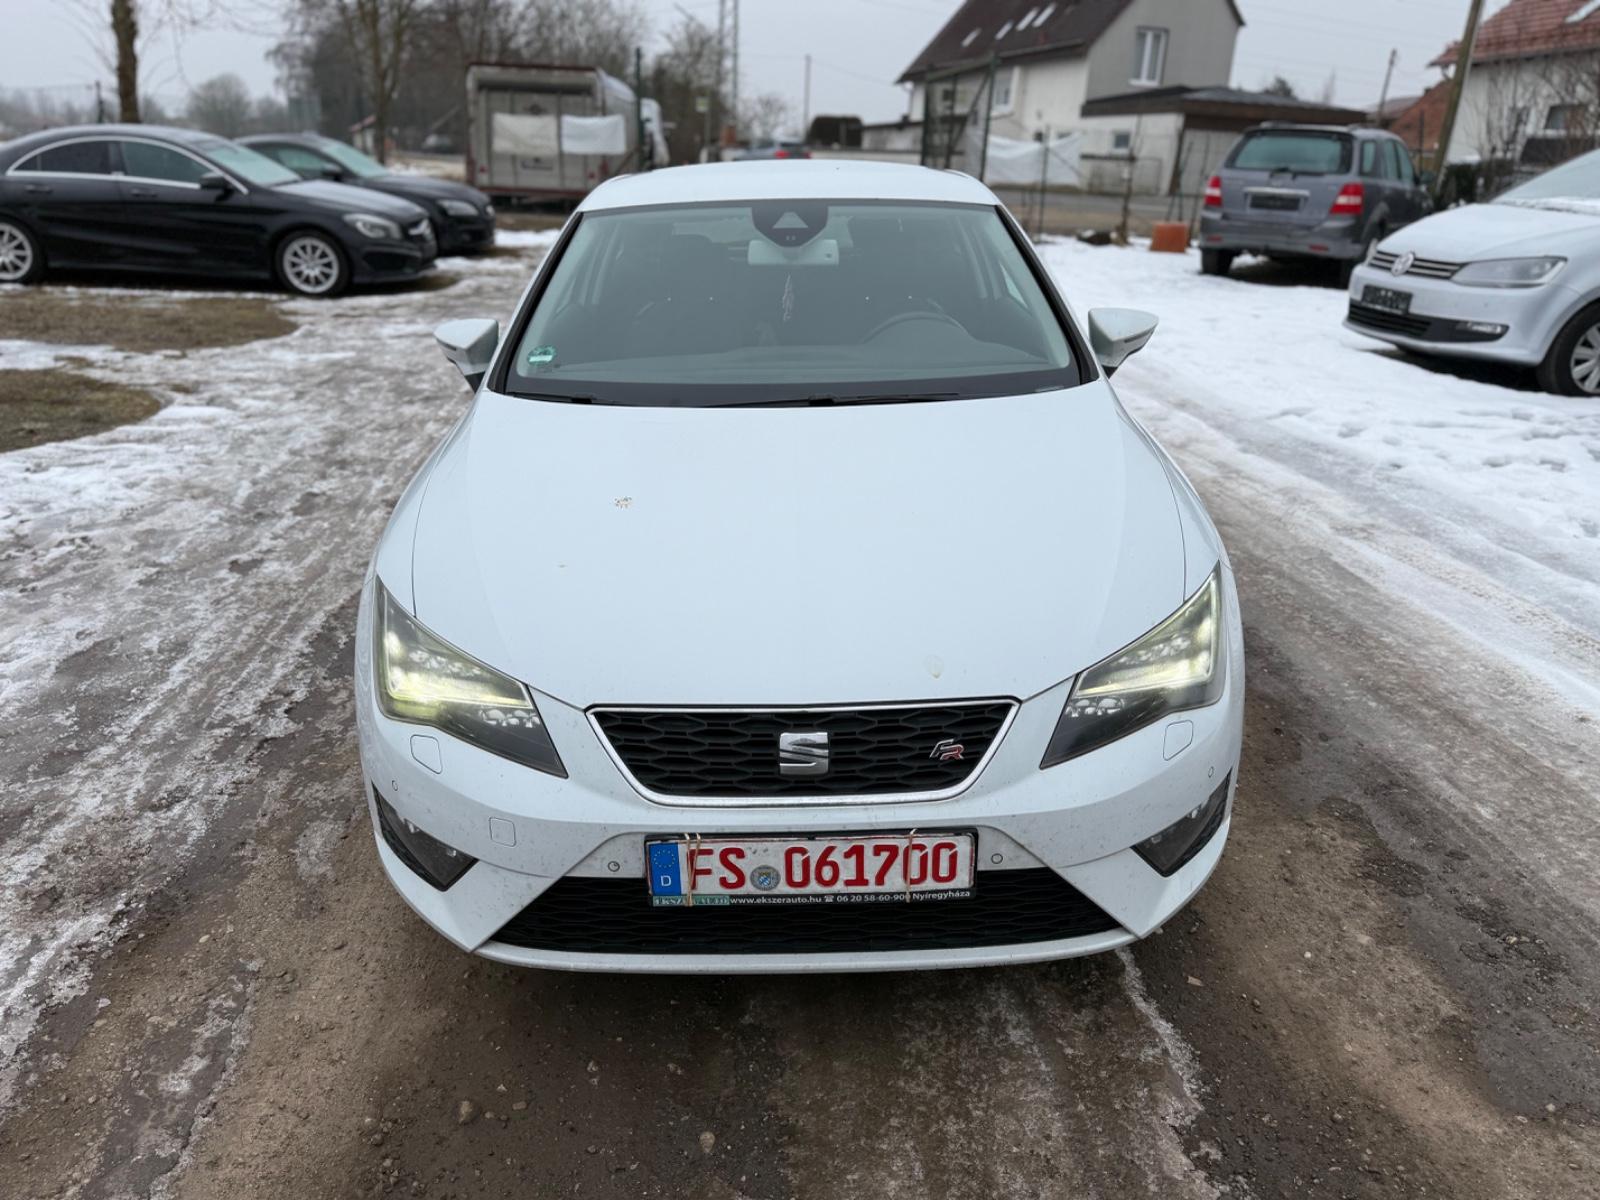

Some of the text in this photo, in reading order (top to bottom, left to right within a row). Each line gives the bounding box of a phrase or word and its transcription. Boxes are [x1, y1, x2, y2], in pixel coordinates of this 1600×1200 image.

[687, 847, 746, 890] FS
[784, 842, 959, 889] 061700
[660, 875, 671, 887] D
[731, 896, 821, 904] www.ekszerauto.hu
[864, 894, 911, 902] 58-60-90
[912, 890, 971, 900] Nyíregyháza
